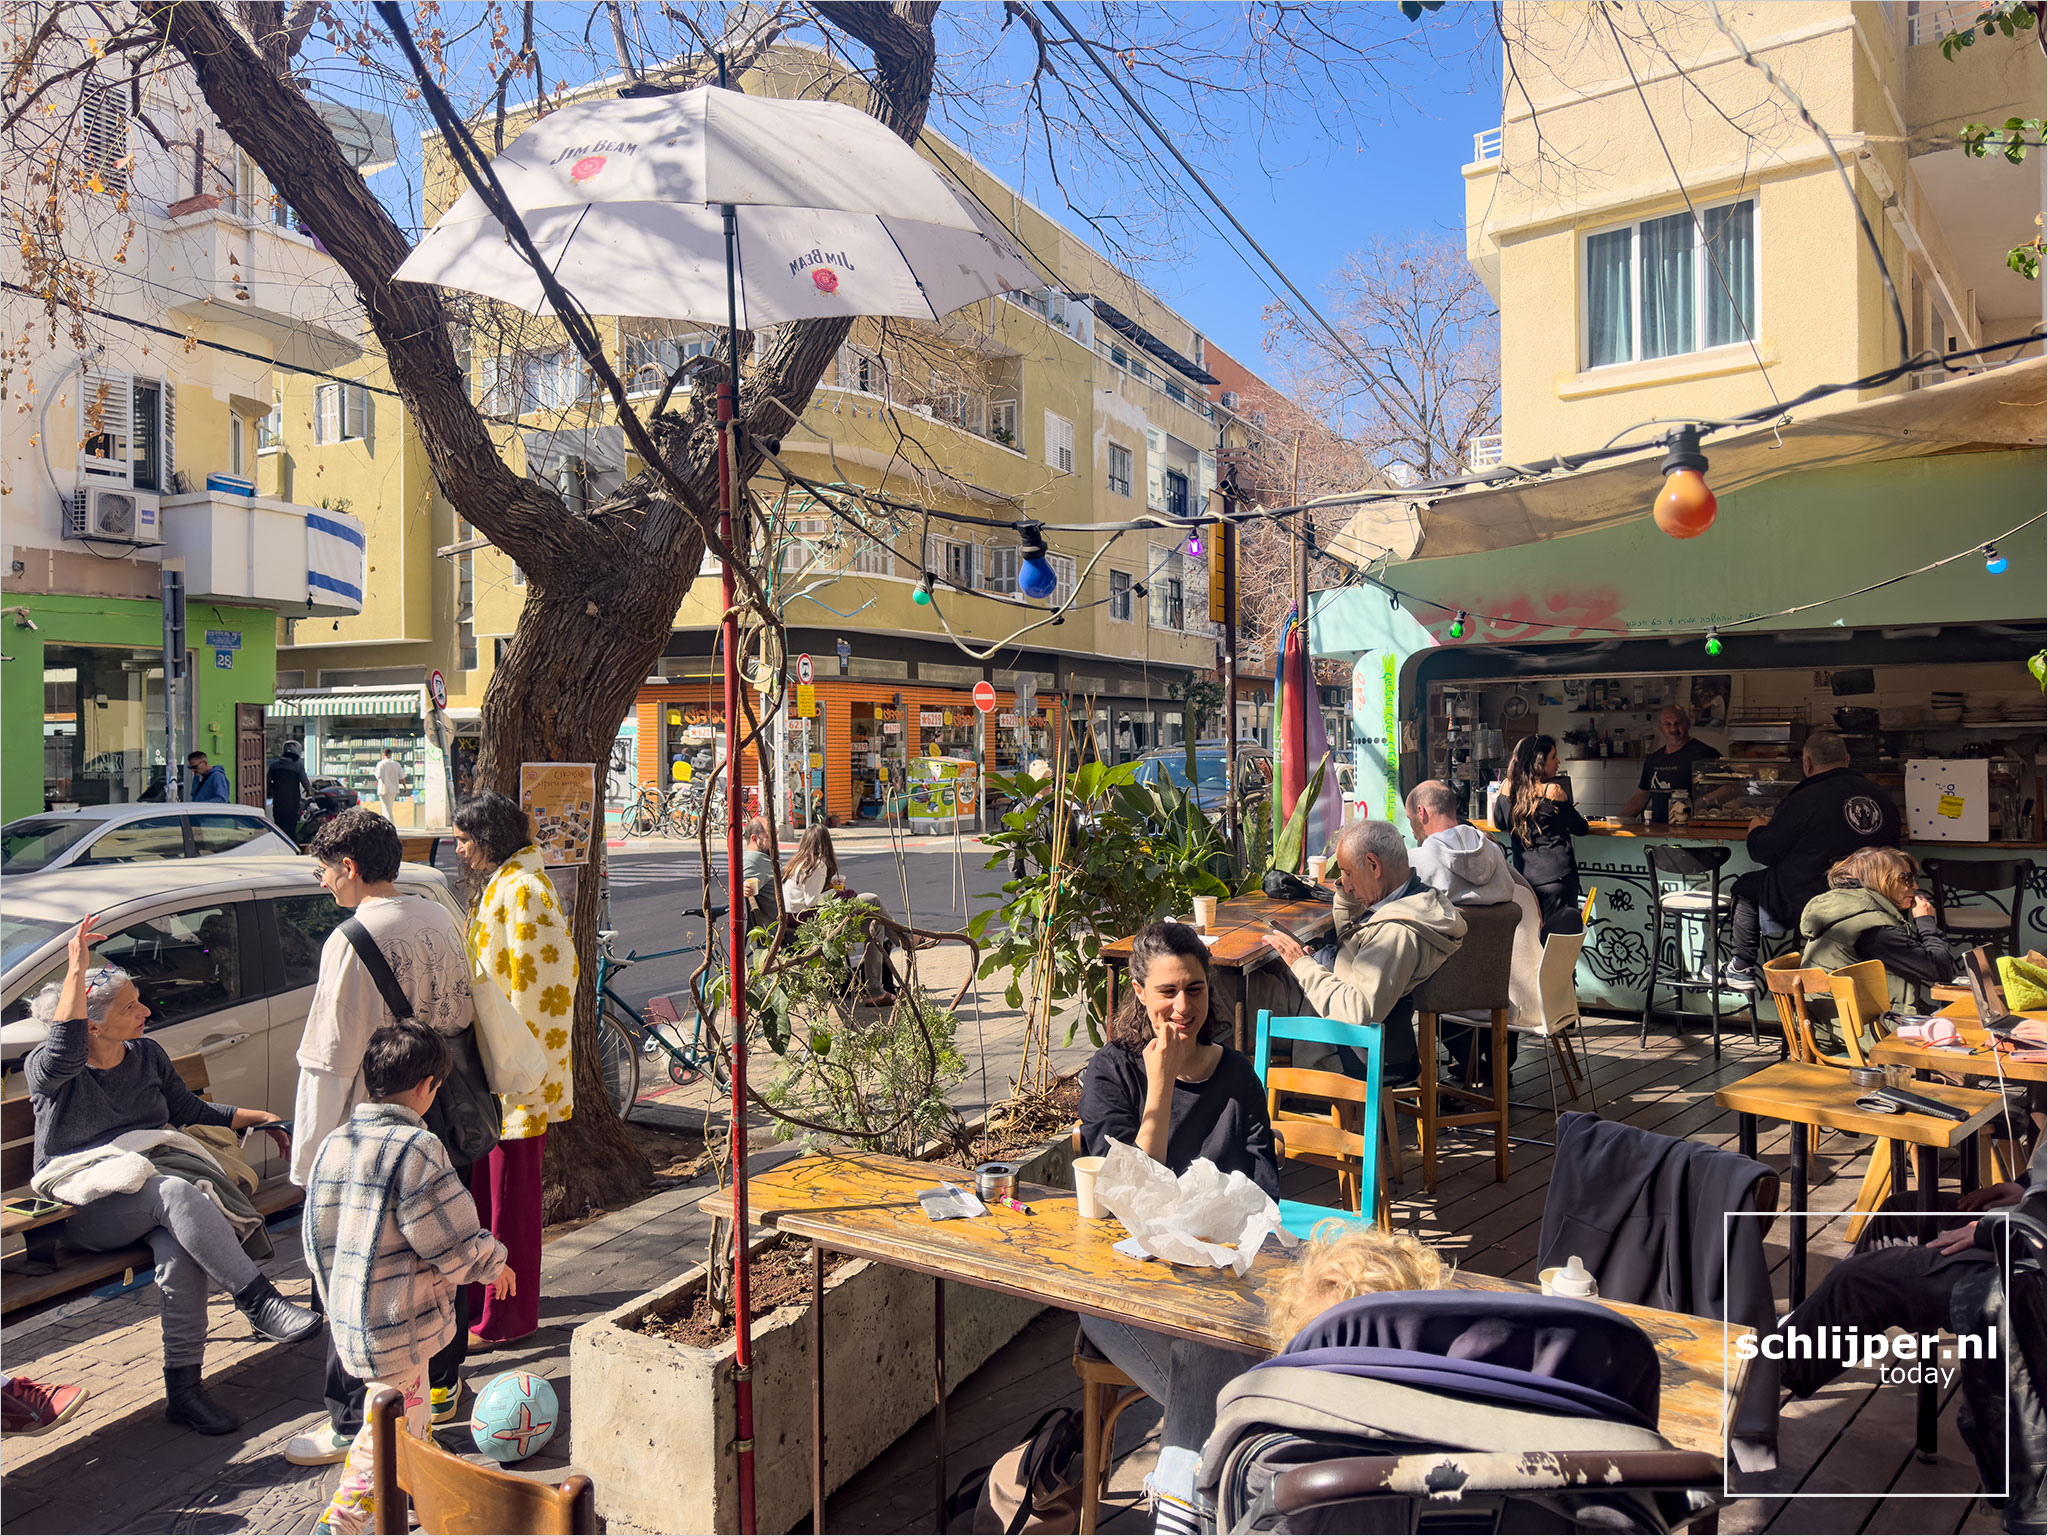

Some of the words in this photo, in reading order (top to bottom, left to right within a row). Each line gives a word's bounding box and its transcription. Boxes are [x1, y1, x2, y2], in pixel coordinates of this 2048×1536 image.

[549, 145, 591, 166] JIM
[591, 139, 638, 157] BEAM
[217, 654, 232, 667] 28
[1384, 712, 1394, 734] לתת
[691, 728, 713, 737] 621
